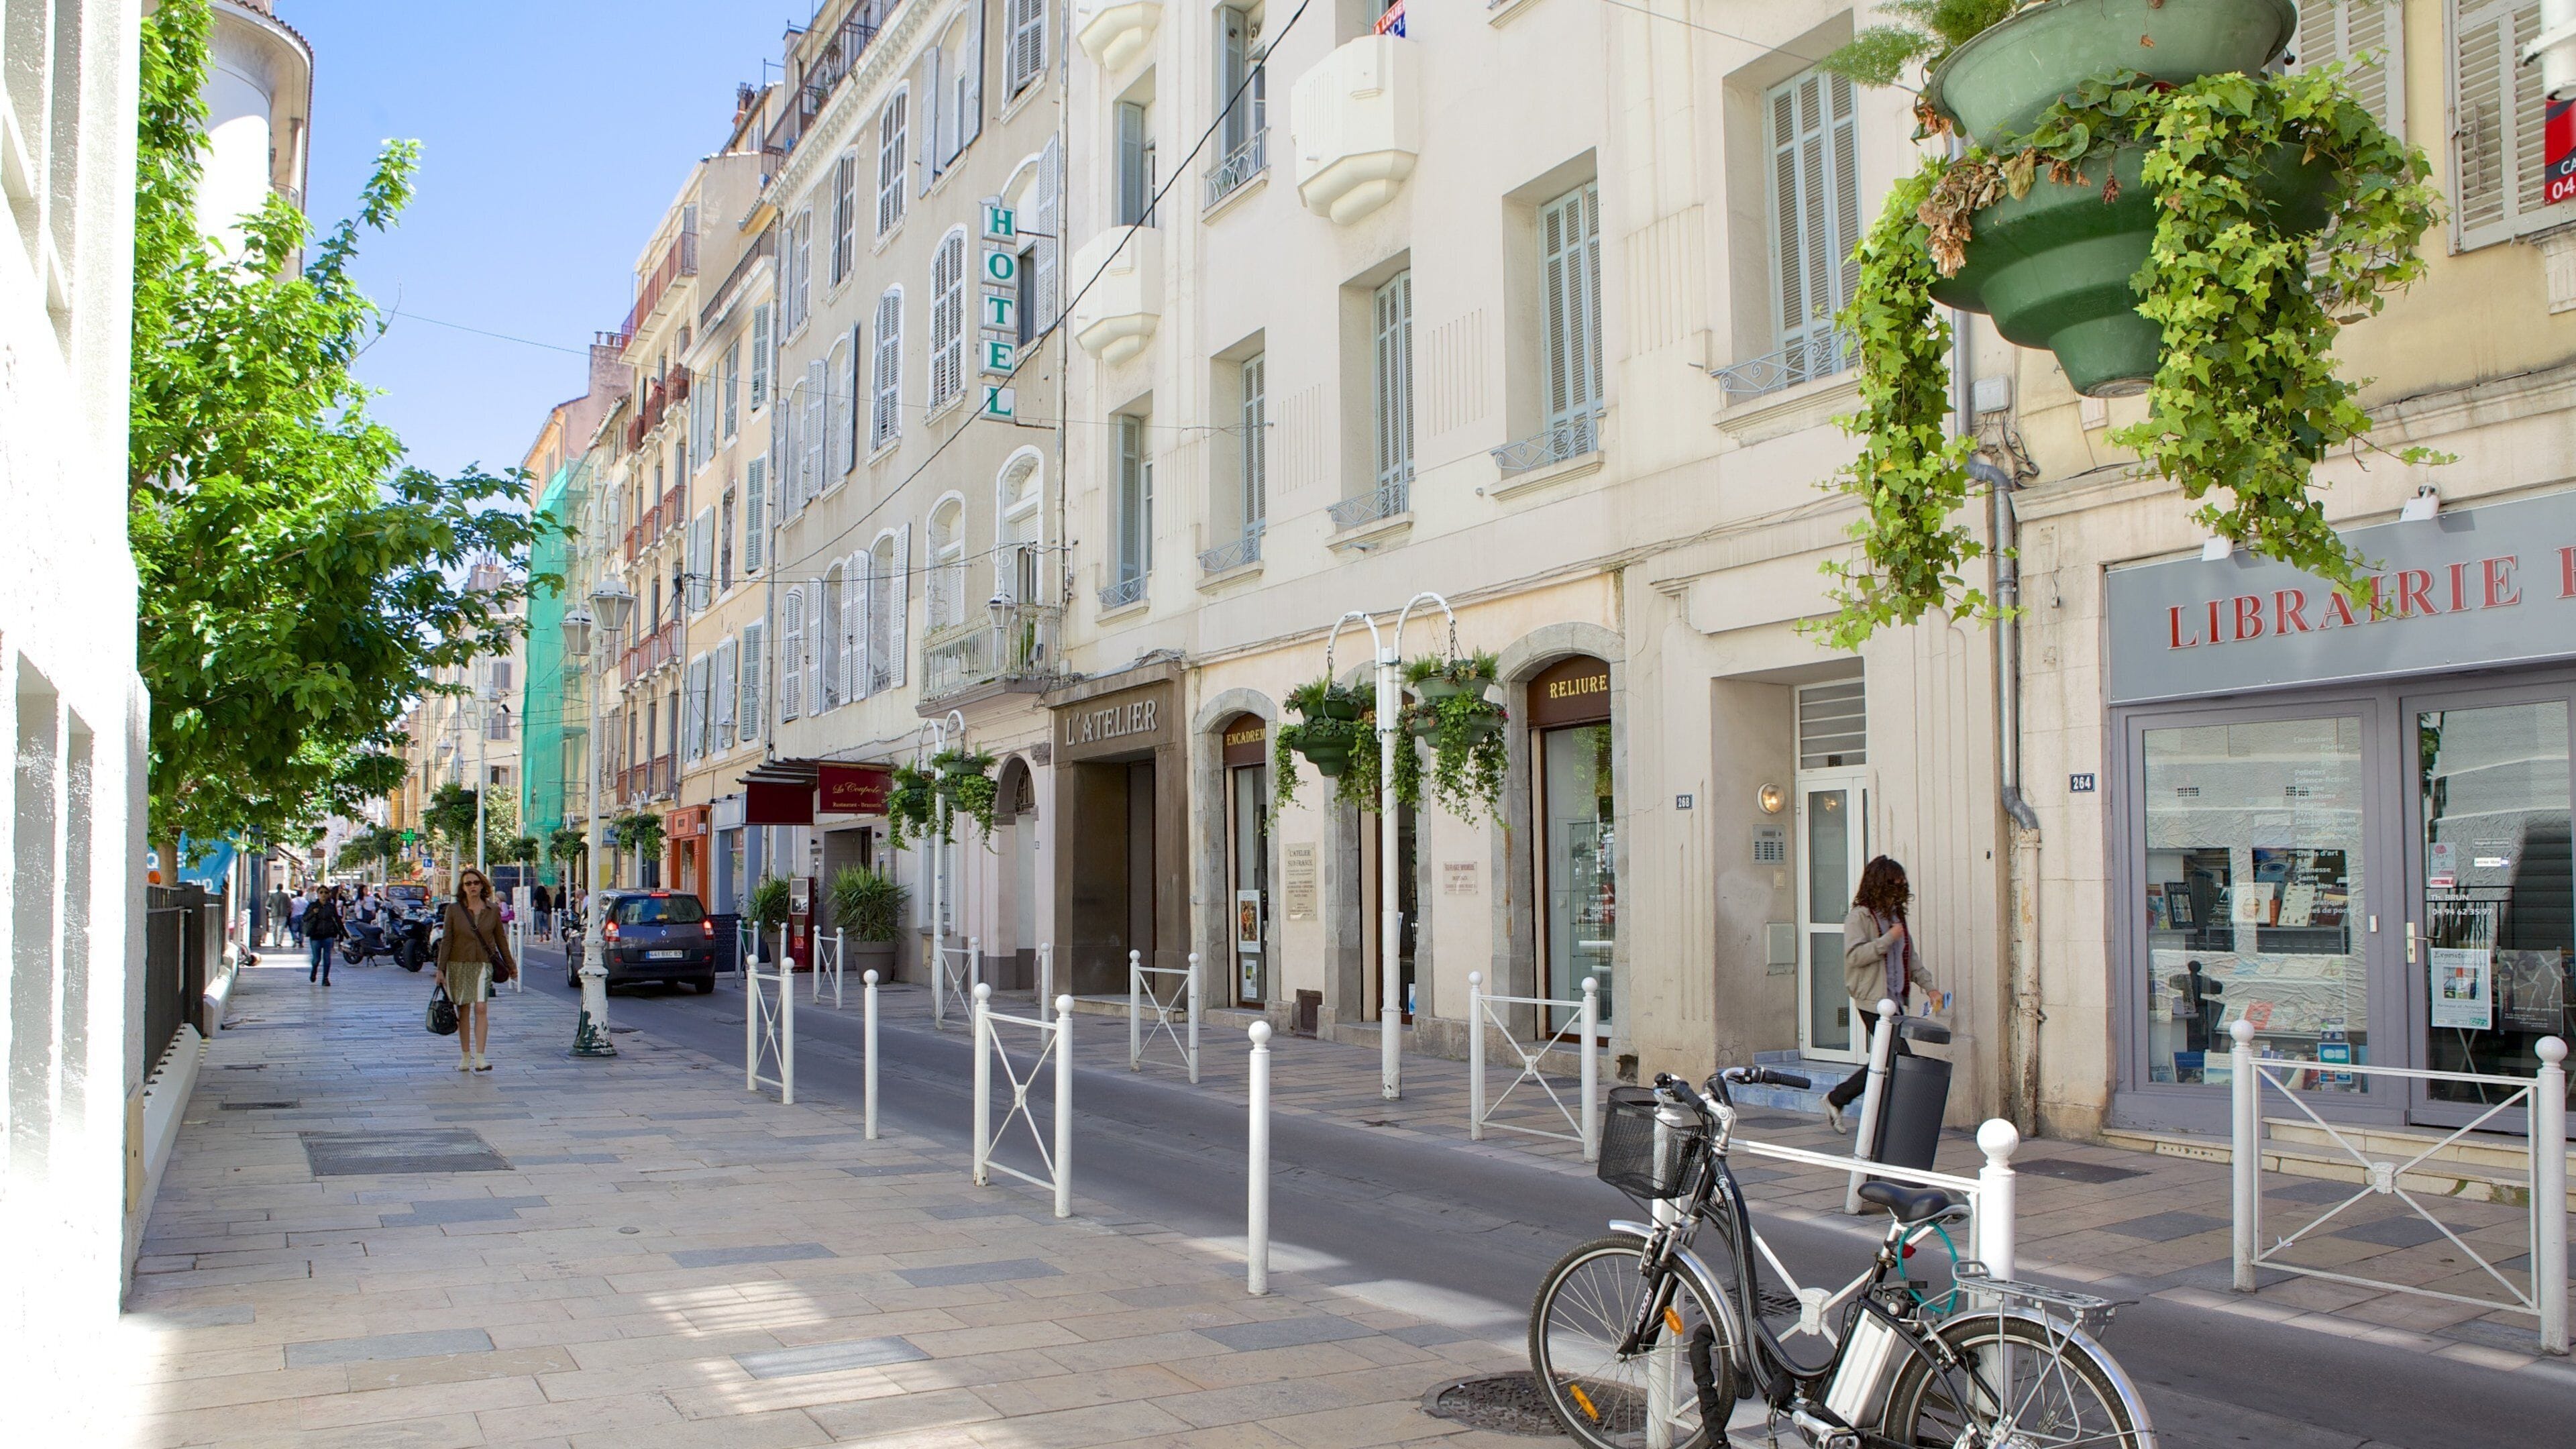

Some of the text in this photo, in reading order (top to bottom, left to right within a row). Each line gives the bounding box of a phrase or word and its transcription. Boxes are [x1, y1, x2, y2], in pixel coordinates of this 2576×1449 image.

[989, 207, 1014, 417] HOTEL
[2166, 554, 2522, 649] LIBRAIRIE
[1550, 674, 1608, 698] RELIURE
[1065, 699, 1158, 746] L'ATELIER
[2073, 776, 2092, 790] 264
[2295, 775, 2350, 784] Science-fiction
[1678, 797, 1690, 808] 268
